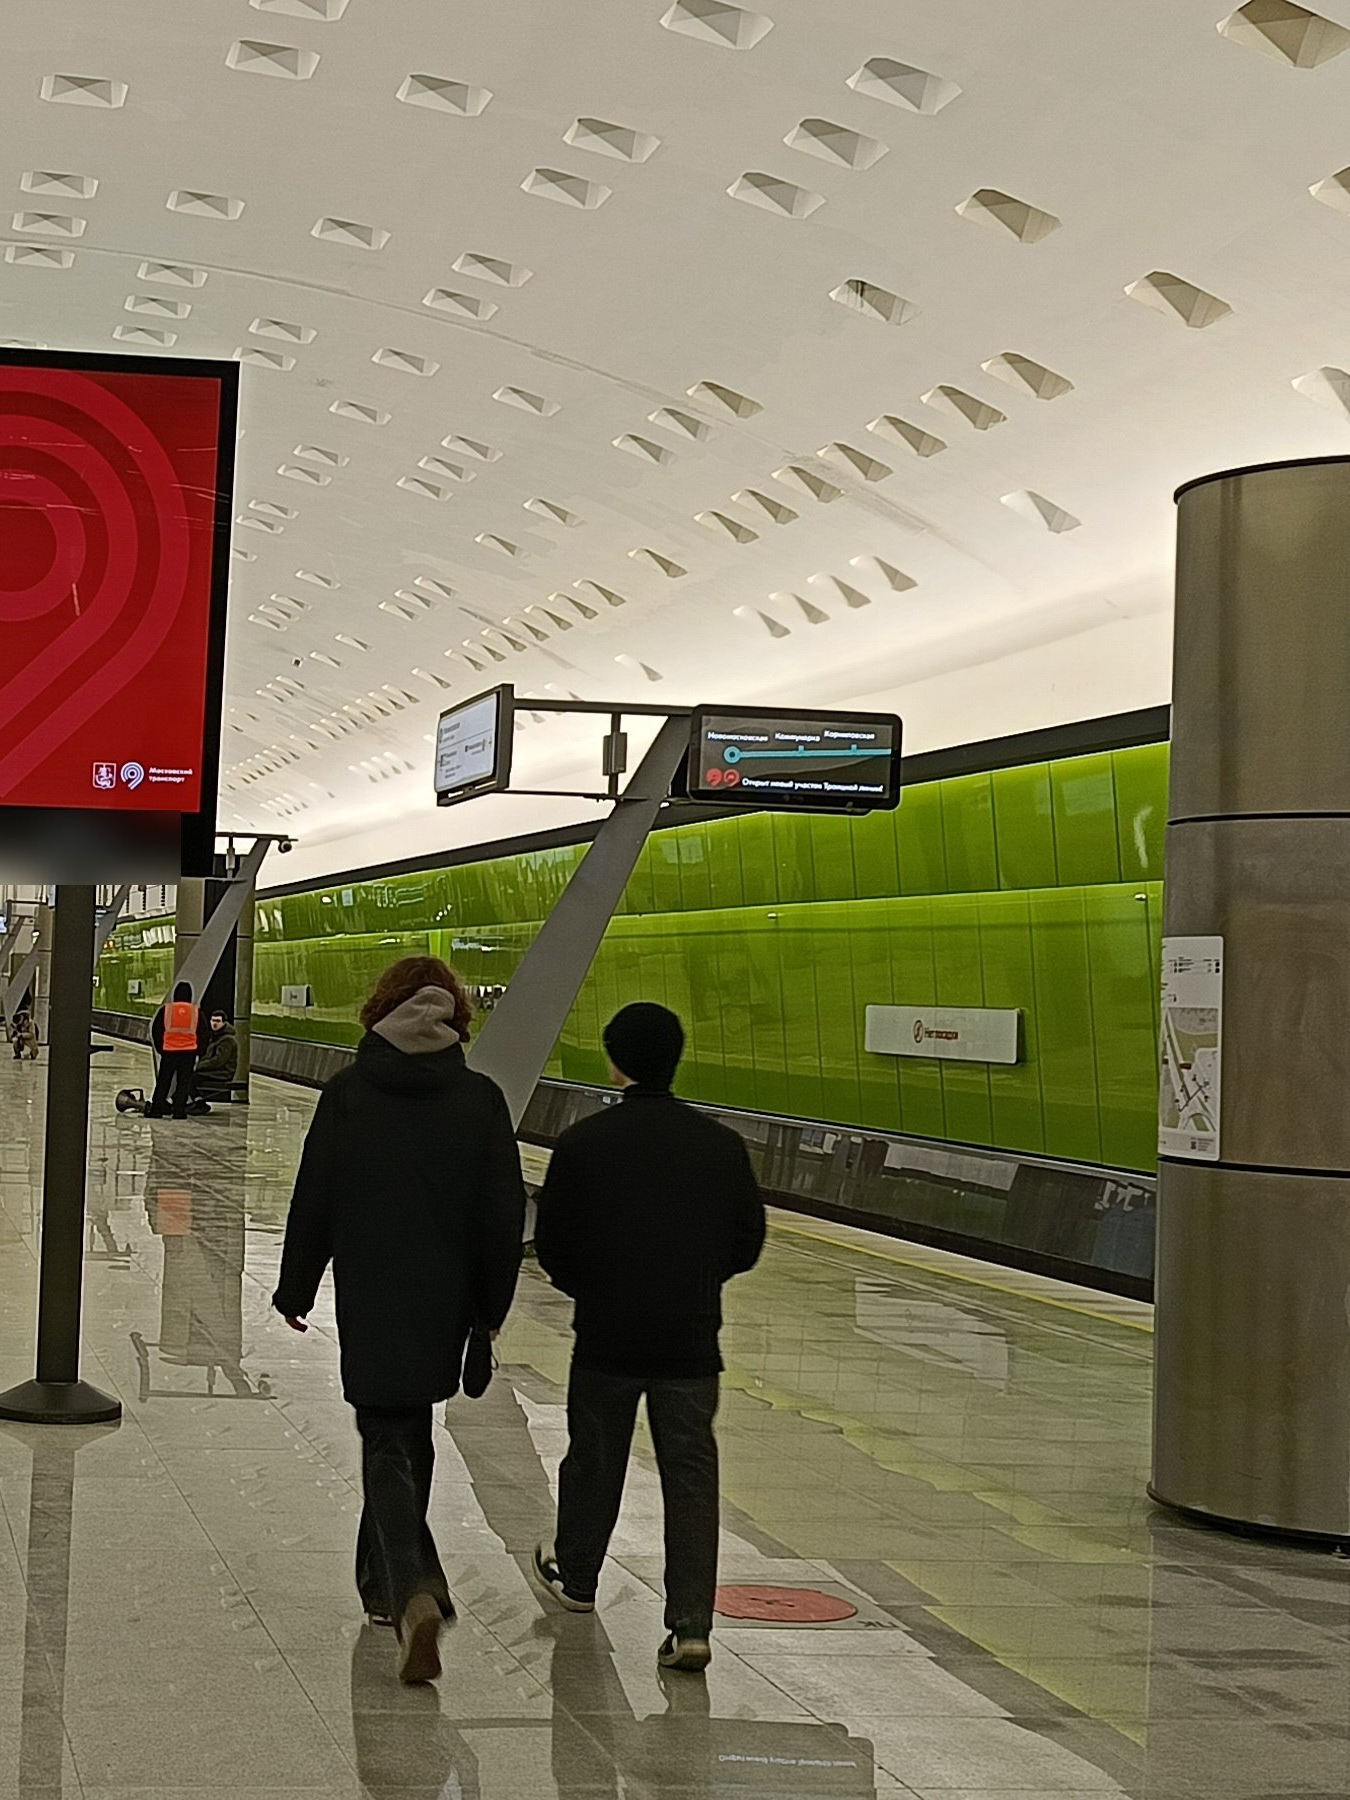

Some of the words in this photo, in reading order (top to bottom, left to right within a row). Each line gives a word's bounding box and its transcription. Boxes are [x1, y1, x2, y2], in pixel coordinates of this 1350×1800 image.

[149, 767, 192, 775] Московский
[742, 777, 770, 788] Открыт
[770, 780, 794, 788] новый
[794, 782, 823, 790] участок
